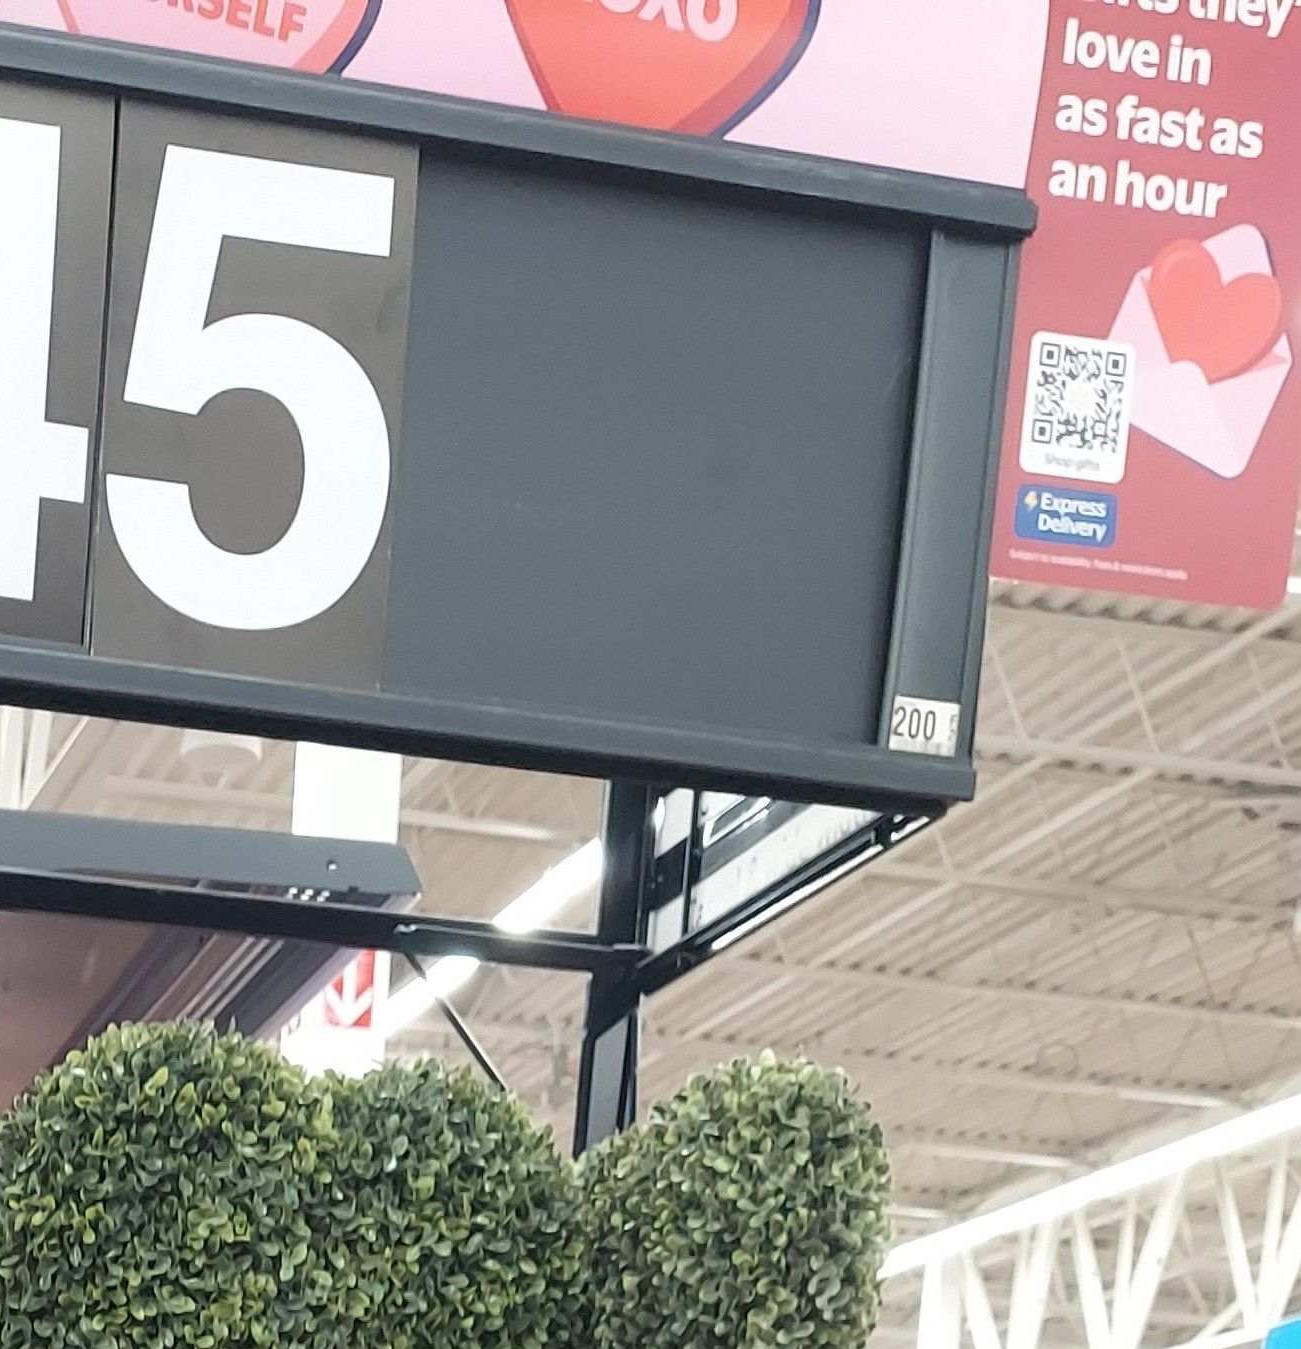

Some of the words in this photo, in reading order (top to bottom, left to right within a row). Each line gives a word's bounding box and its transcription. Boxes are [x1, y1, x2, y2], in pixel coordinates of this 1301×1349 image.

[1062, 17, 1160, 78] love
[1166, 34, 1211, 85] in
[1055, 94, 1108, 136] as
[1115, 94, 1205, 151] fast
[1210, 117, 1264, 159] as
[1048, 159, 1107, 202] an
[1114, 160, 1228, 218] hour
[1037, 513, 1108, 542] Delivery
[1040, 492, 1107, 518] Express
[892, 705, 936, 741] 200
